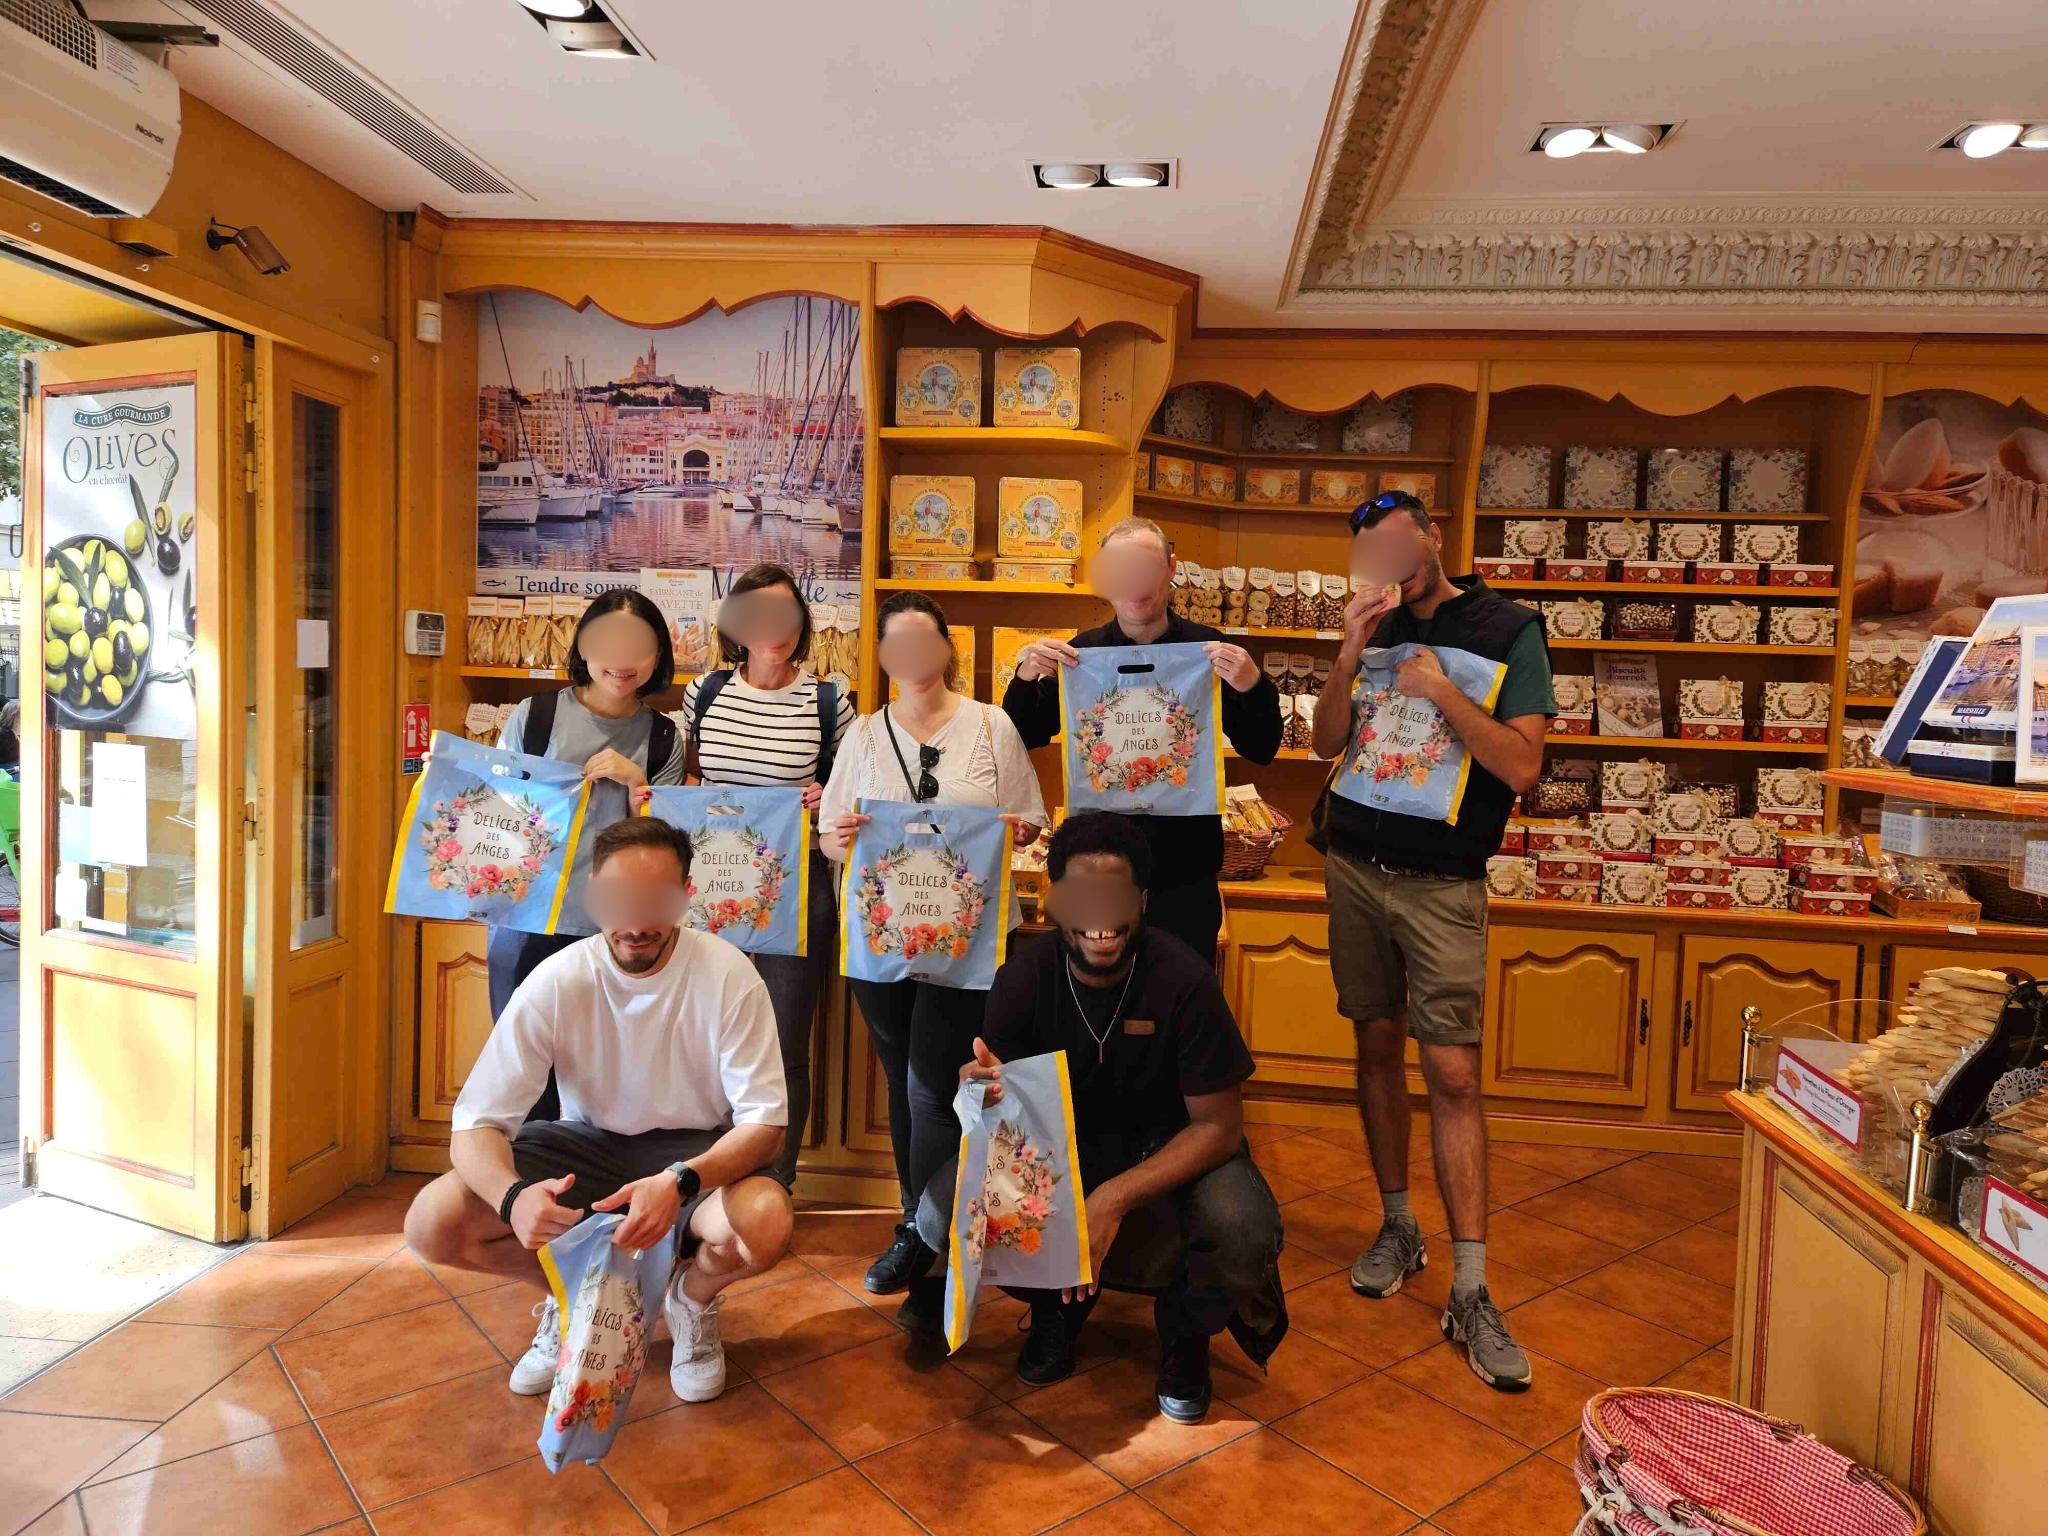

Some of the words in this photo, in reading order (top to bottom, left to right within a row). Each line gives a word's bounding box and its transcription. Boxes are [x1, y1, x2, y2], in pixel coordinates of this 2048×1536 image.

[78, 413, 89, 425] LA
[91, 411, 114, 425] CURE
[114, 407, 166, 422] GOURMANDE
[515, 575, 579, 594] Tendre
[585, 583, 641, 595] souve
[1955, 706, 1988, 715] MARSEILLE
[1131, 727, 1145, 735] DES
[1399, 723, 1411, 733] DES
[1120, 738, 1160, 753] ANGES
[1382, 730, 1417, 748] ANGES
[486, 832, 500, 841] DES
[469, 841, 511, 860] ANGES
[718, 869, 732, 877] DES
[704, 880, 745, 893] ANGES
[914, 890, 929, 899] DES
[900, 902, 942, 917] ANGES
